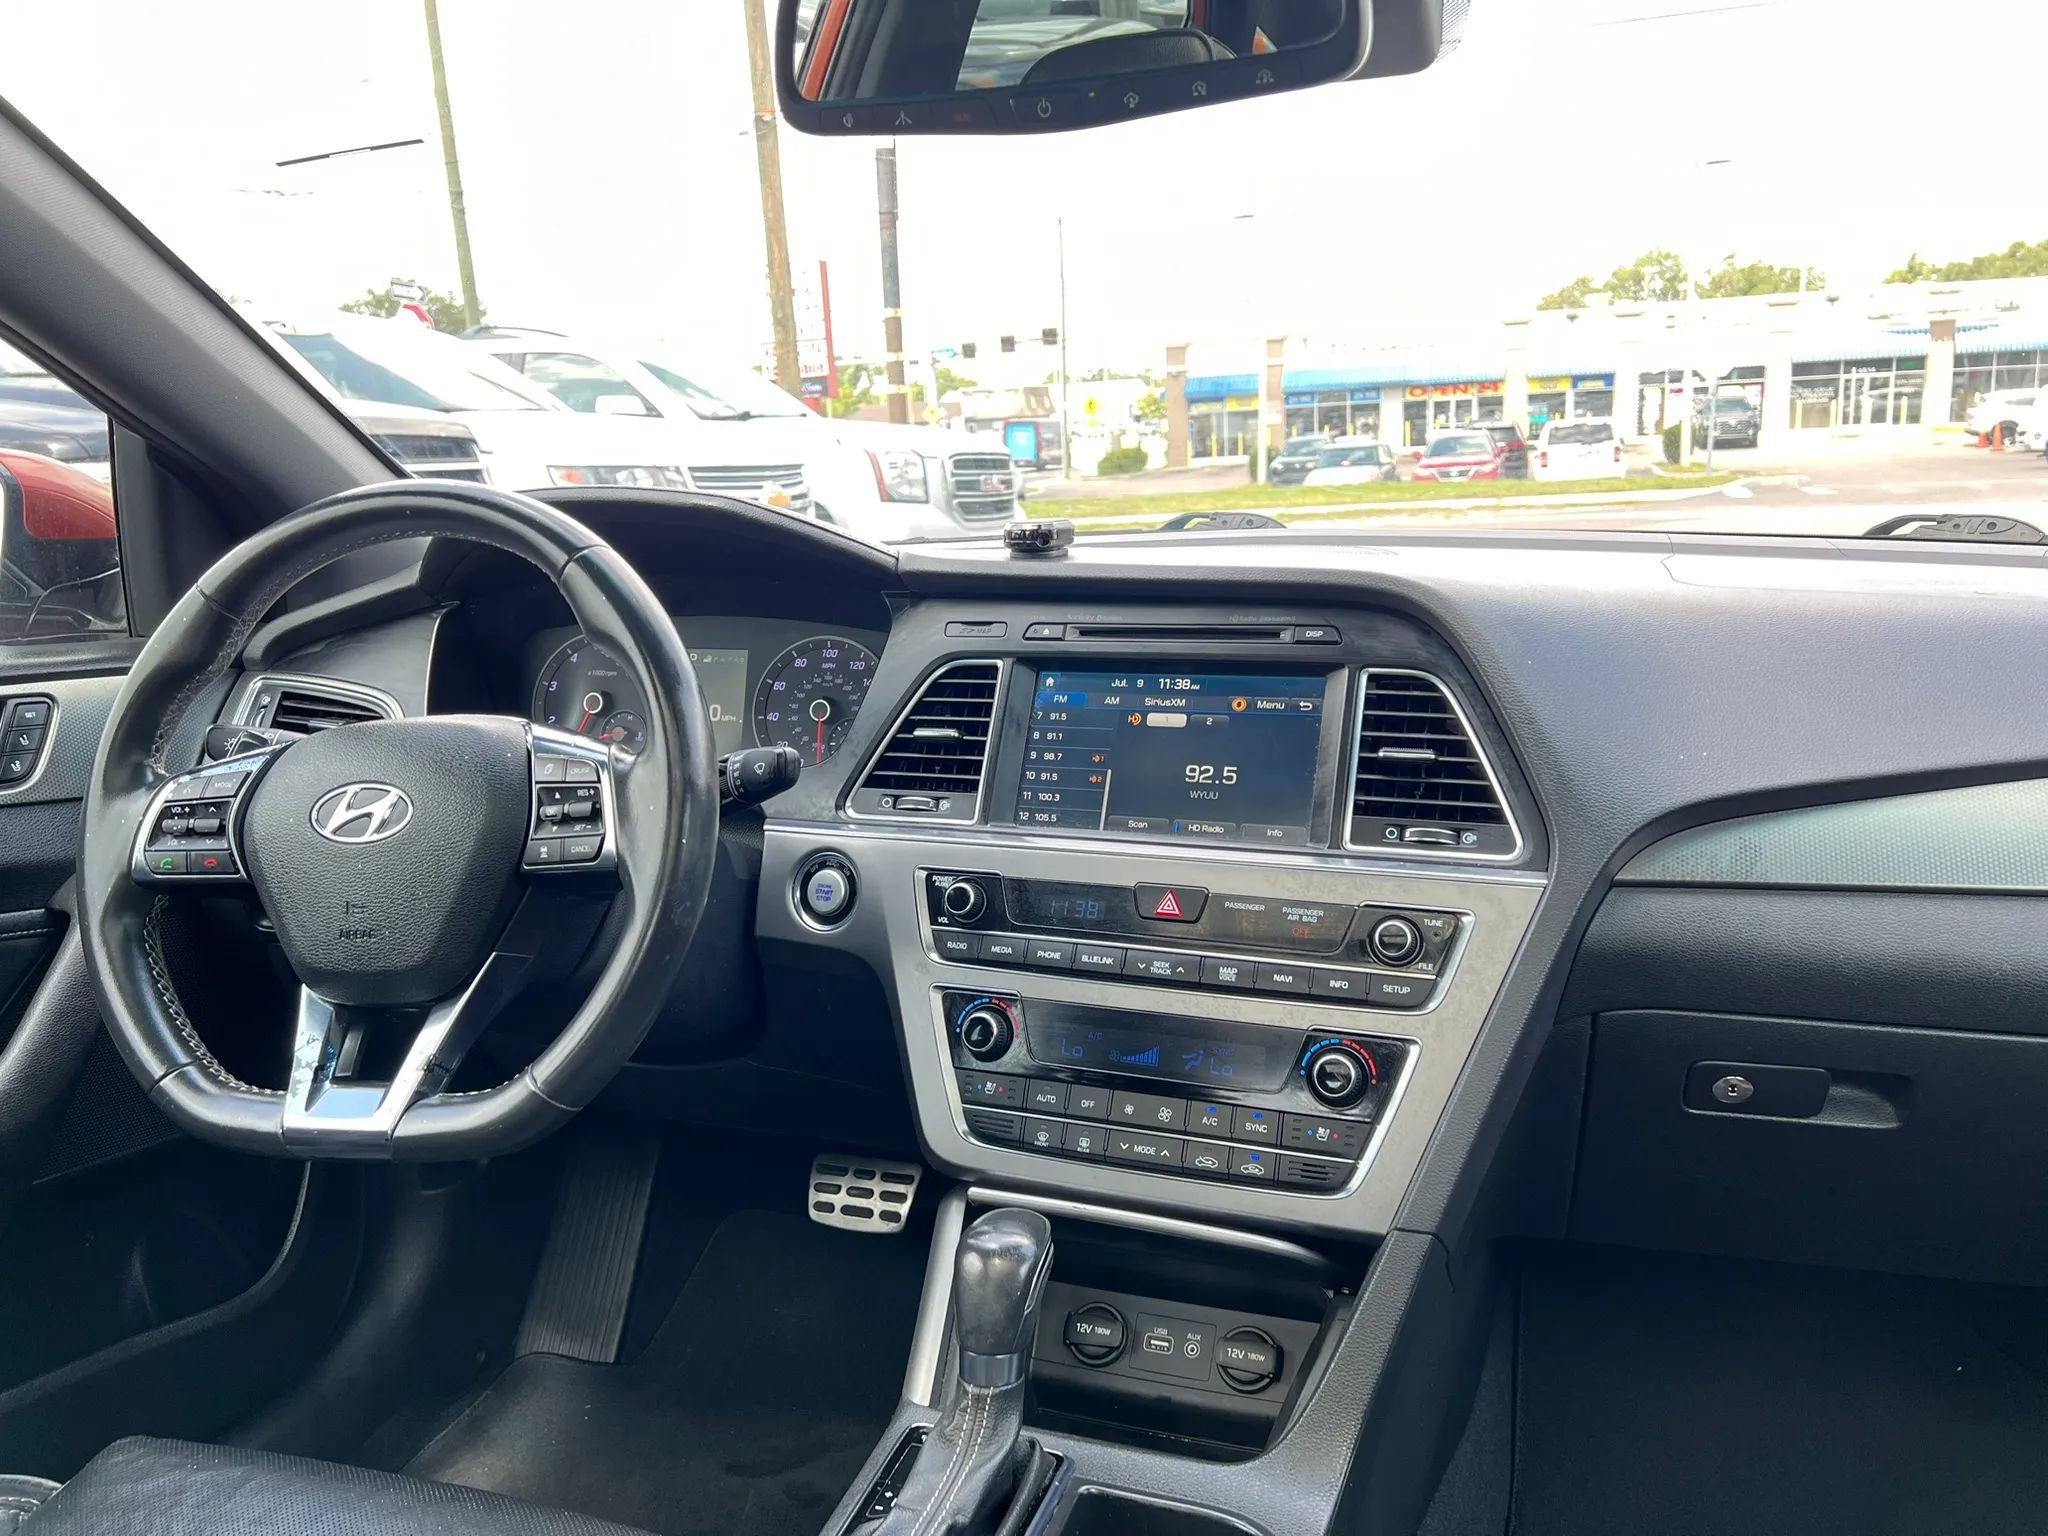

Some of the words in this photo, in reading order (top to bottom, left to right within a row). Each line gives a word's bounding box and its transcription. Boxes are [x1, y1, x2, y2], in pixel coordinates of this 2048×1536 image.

[570, 652, 578, 662] 4
[822, 649, 838, 658] 100
[794, 658, 808, 668] 80
[849, 661, 865, 670] 120
[549, 681, 557, 691] 3
[773, 681, 786, 691] 60
[1136, 679, 1144, 688] 9
[1053, 695, 1068, 704] FM
[1104, 696, 1120, 705] AM
[1144, 698, 1186, 707] SiriusXM
[1257, 700, 1285, 710] Menu
[710, 704, 721, 721] 0
[766, 712, 779, 721] 40
[1050, 712, 1067, 721] 91.5
[548, 716, 556, 724] 2
[1044, 752, 1062, 761] 98.7
[1041, 773, 1058, 781] 91.5
[1185, 765, 1237, 785] 92.5
[1038, 793, 1060, 801] 100.3
[1190, 791, 1219, 800] WYUU
[1035, 813, 1057, 822] 105.5
[1202, 825, 1224, 833] Radio
[1267, 829, 1283, 837] Info
[570, 845, 592, 853] CANCEL
[1224, 901, 1265, 911] PASSENGER
[1282, 907, 1324, 917] PASSENGER
[1424, 918, 1443, 927] TUNE
[947, 941, 967, 950] RADIO
[991, 946, 1012, 955] MEDIA
[1037, 951, 1061, 960] PHONE
[1081, 955, 1114, 965] BLUELINK
[1153, 960, 1170, 968] SEEK
[1150, 966, 1172, 975] TRACK
[1273, 974, 1293, 983] NAVI
[1330, 980, 1348, 989] INFO
[1382, 984, 1410, 994] SETUP
[1037, 1094, 1056, 1104] AUTO
[1081, 1100, 1095, 1108] OFF
[1202, 1116, 1218, 1126] A/C
[1245, 1123, 1268, 1133] SYNC
[1134, 1145, 1156, 1155] MODE
[1076, 1323, 1093, 1334] 12V
[1227, 1348, 1244, 1359] 12V
